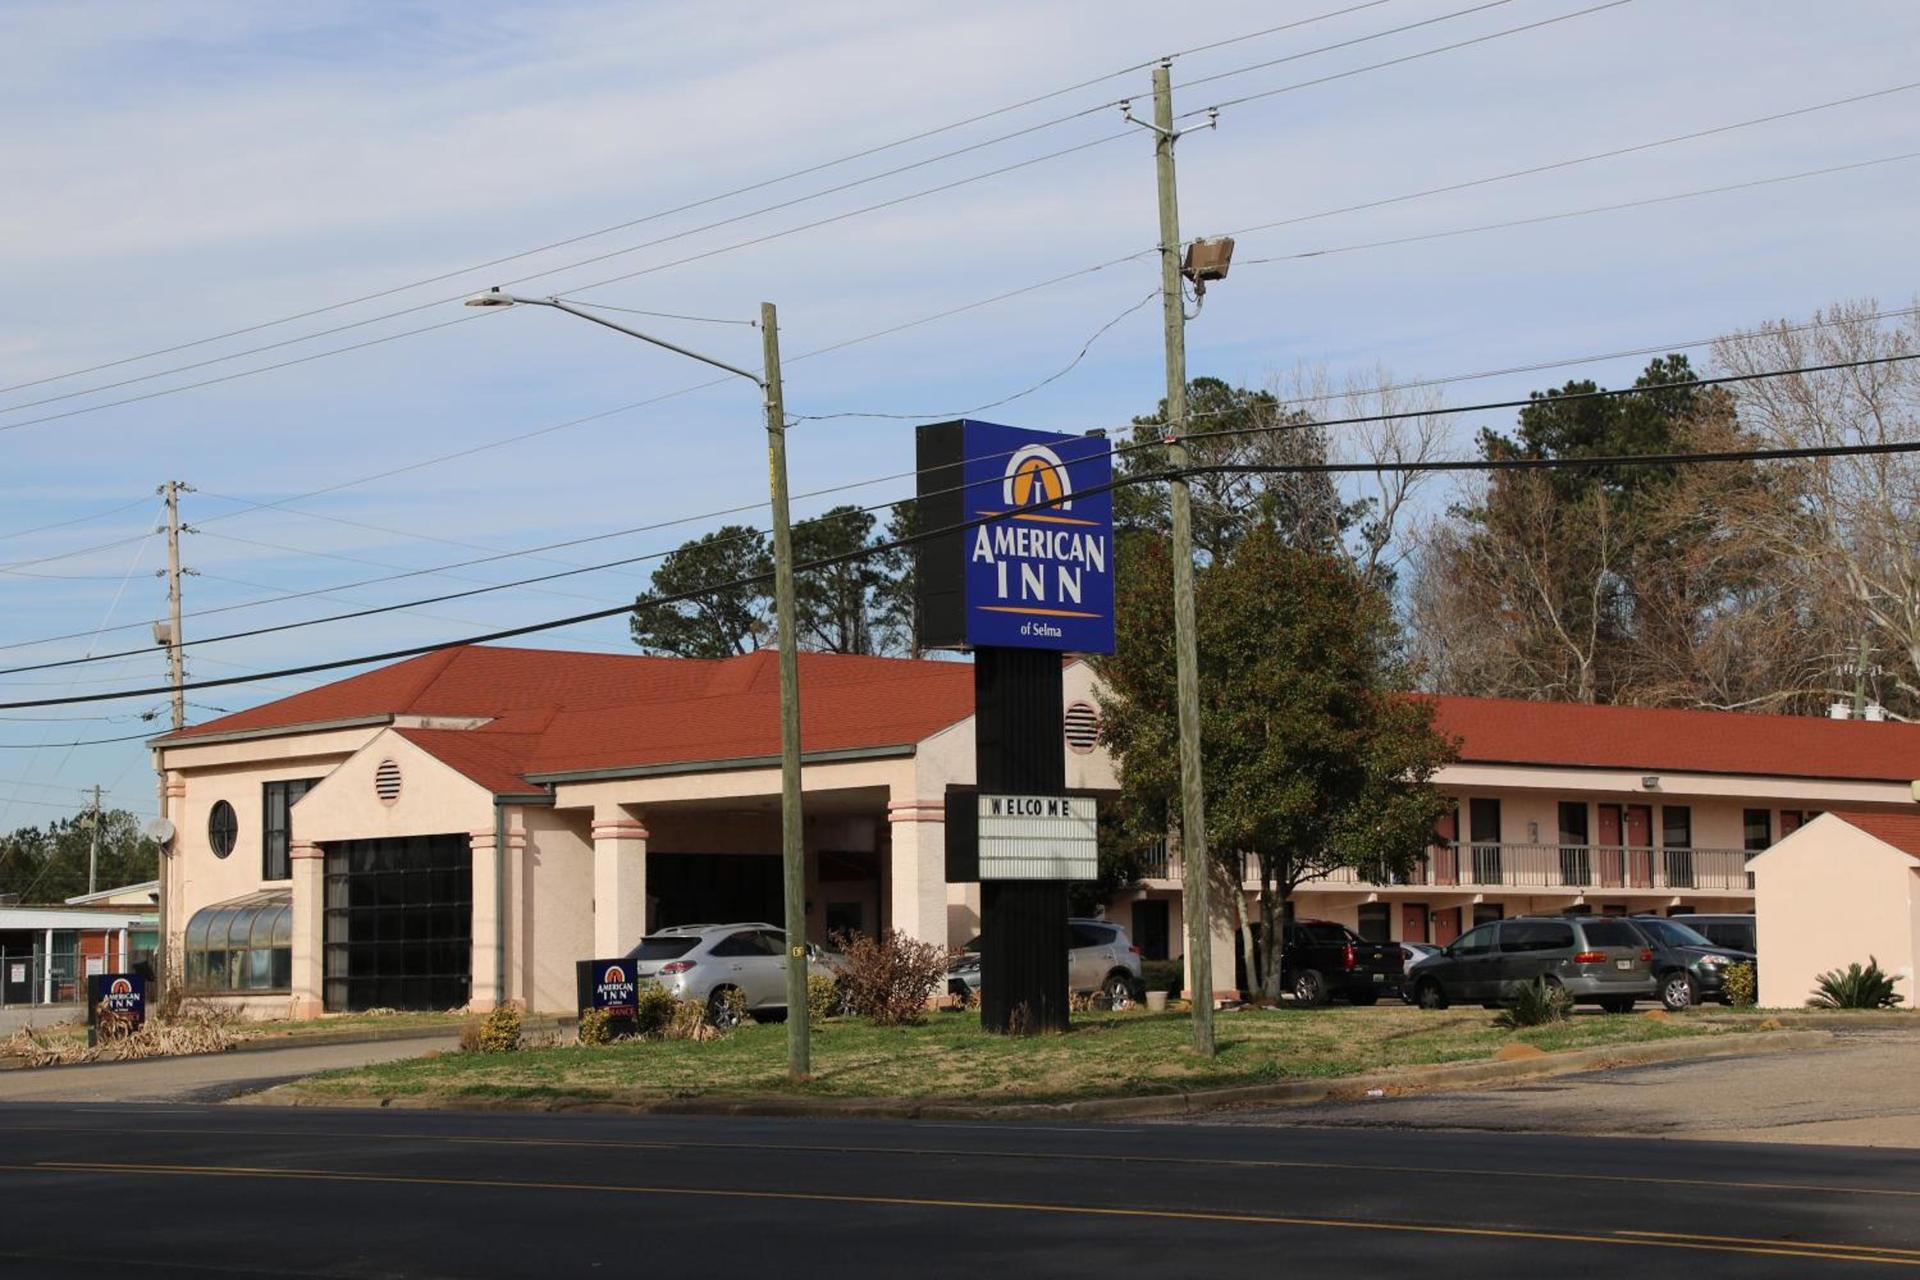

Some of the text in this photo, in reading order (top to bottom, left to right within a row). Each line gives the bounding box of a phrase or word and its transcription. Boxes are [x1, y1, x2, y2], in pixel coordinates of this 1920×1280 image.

[973, 524, 1104, 573] AMERICAN
[998, 561, 1081, 603] INN
[1021, 622, 1062, 637] of Selma
[992, 799, 1069, 817] WELCOME
[597, 982, 633, 993] AMERICAN
[603, 991, 627, 1000] INN
